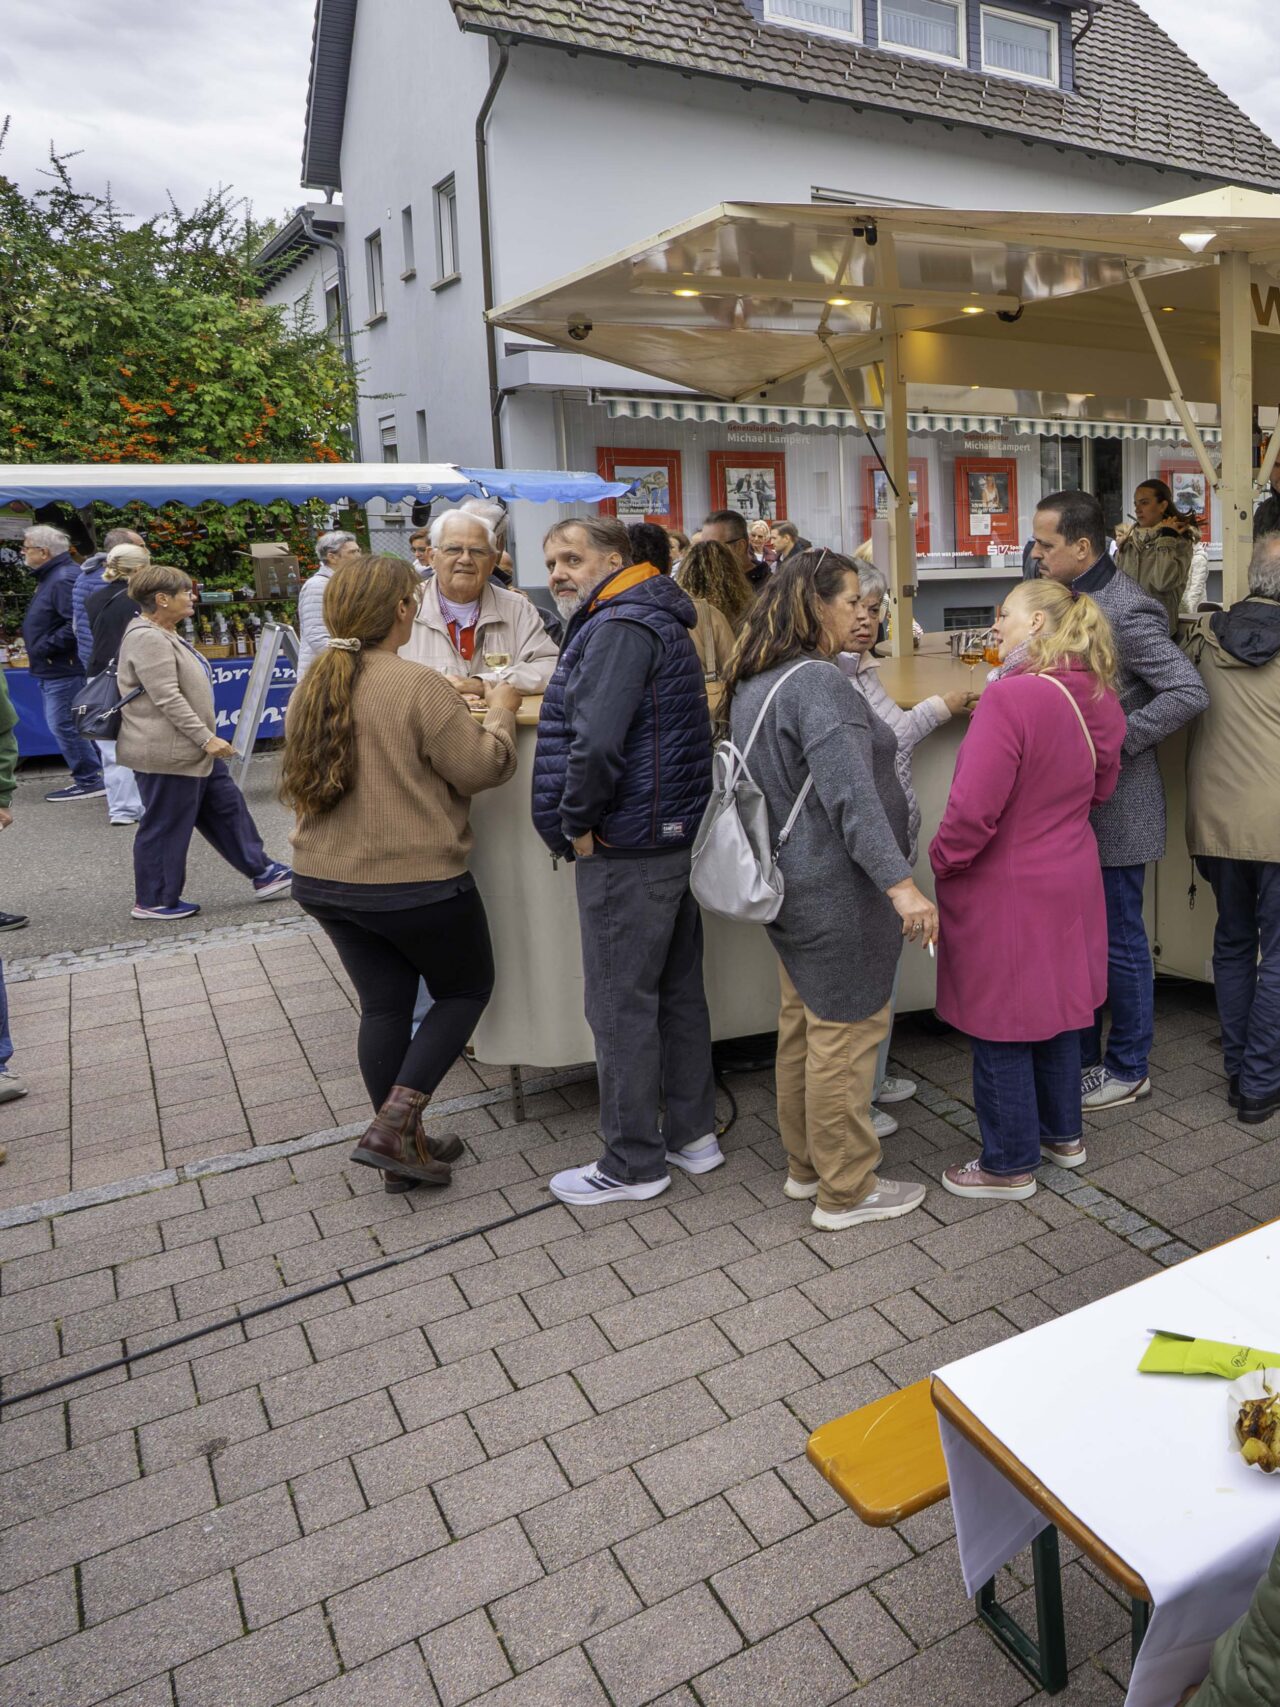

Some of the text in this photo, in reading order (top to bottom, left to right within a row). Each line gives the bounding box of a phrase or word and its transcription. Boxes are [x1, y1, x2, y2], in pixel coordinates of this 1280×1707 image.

[727, 423, 785, 433] Generalagentur
[727, 432, 811, 446] Michael Lampert
[964, 441, 1032, 453] Michael Lampert
